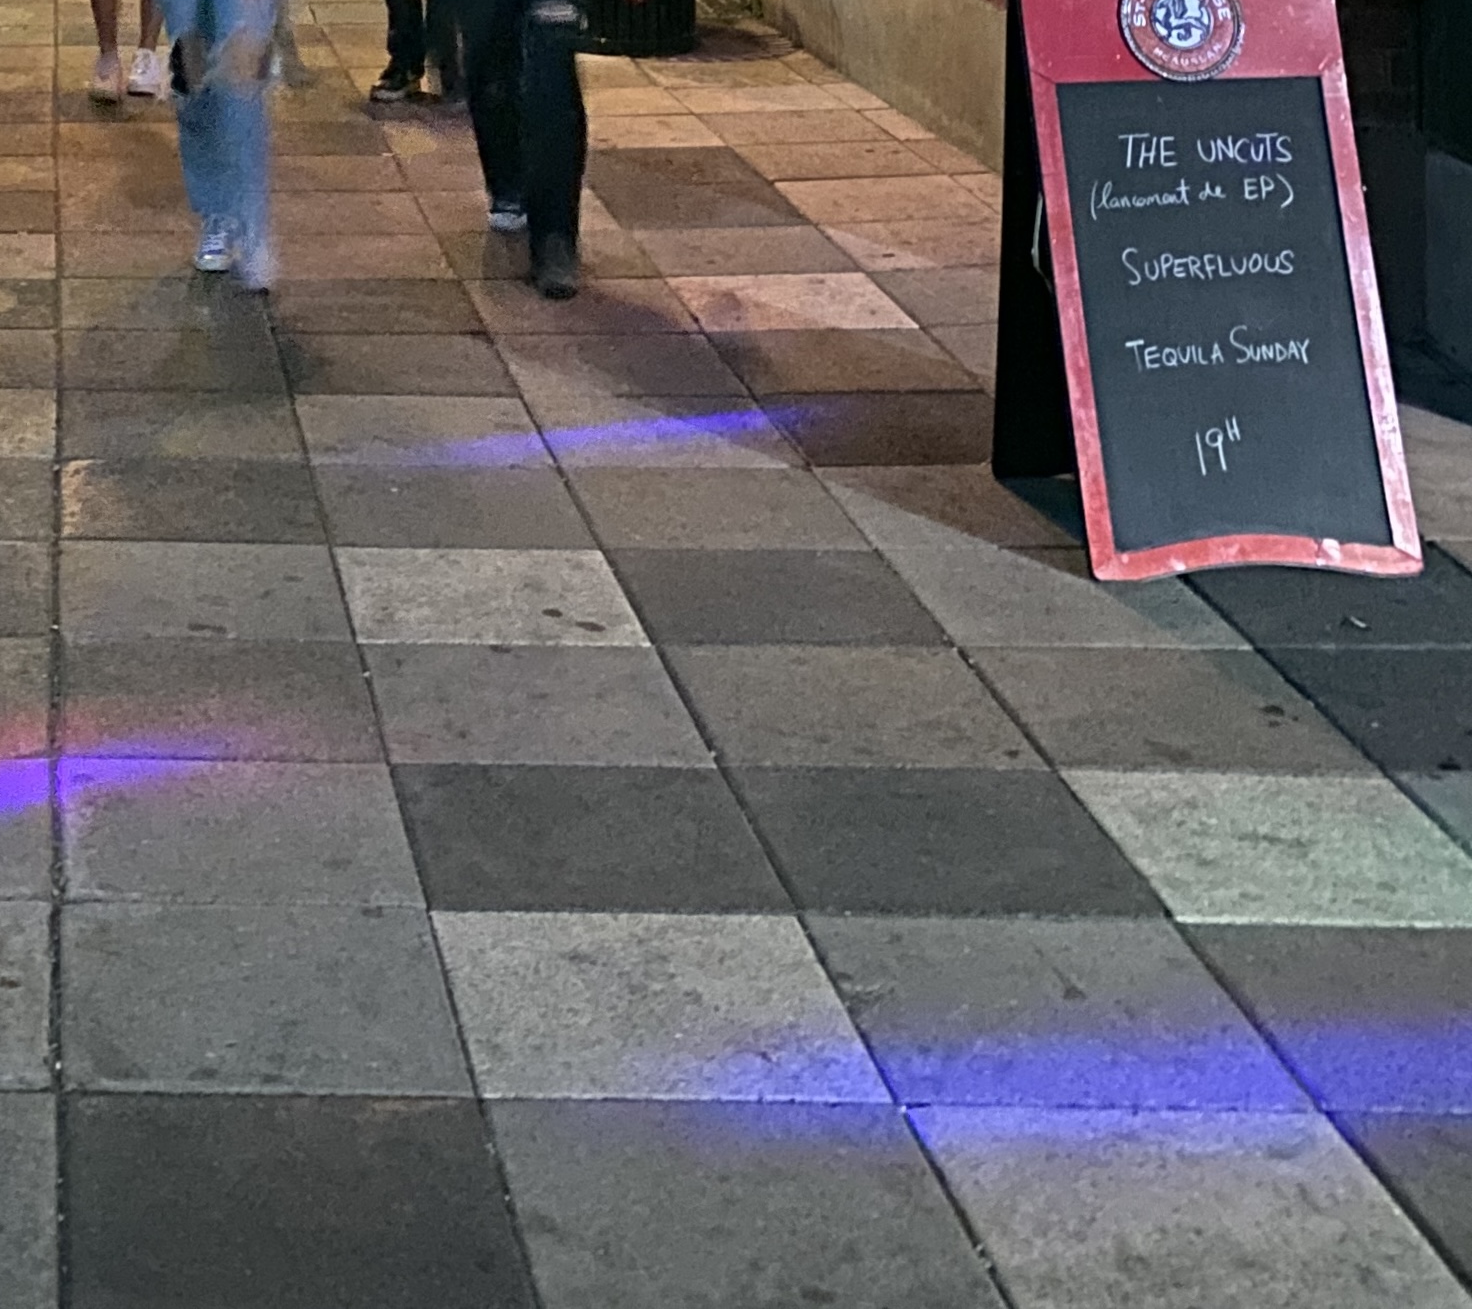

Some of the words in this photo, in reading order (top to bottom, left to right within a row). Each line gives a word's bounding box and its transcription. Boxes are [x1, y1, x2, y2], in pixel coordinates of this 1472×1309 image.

[1118, 132, 1178, 169] THE
[1197, 132, 1294, 164] UNCUTS
[1243, 173, 1295, 209] EP)
[1122, 247, 1295, 286] SUPERFLUOUS
[1125, 339, 1225, 373] TEQUILA
[1229, 325, 1310, 365] SUNDAY
